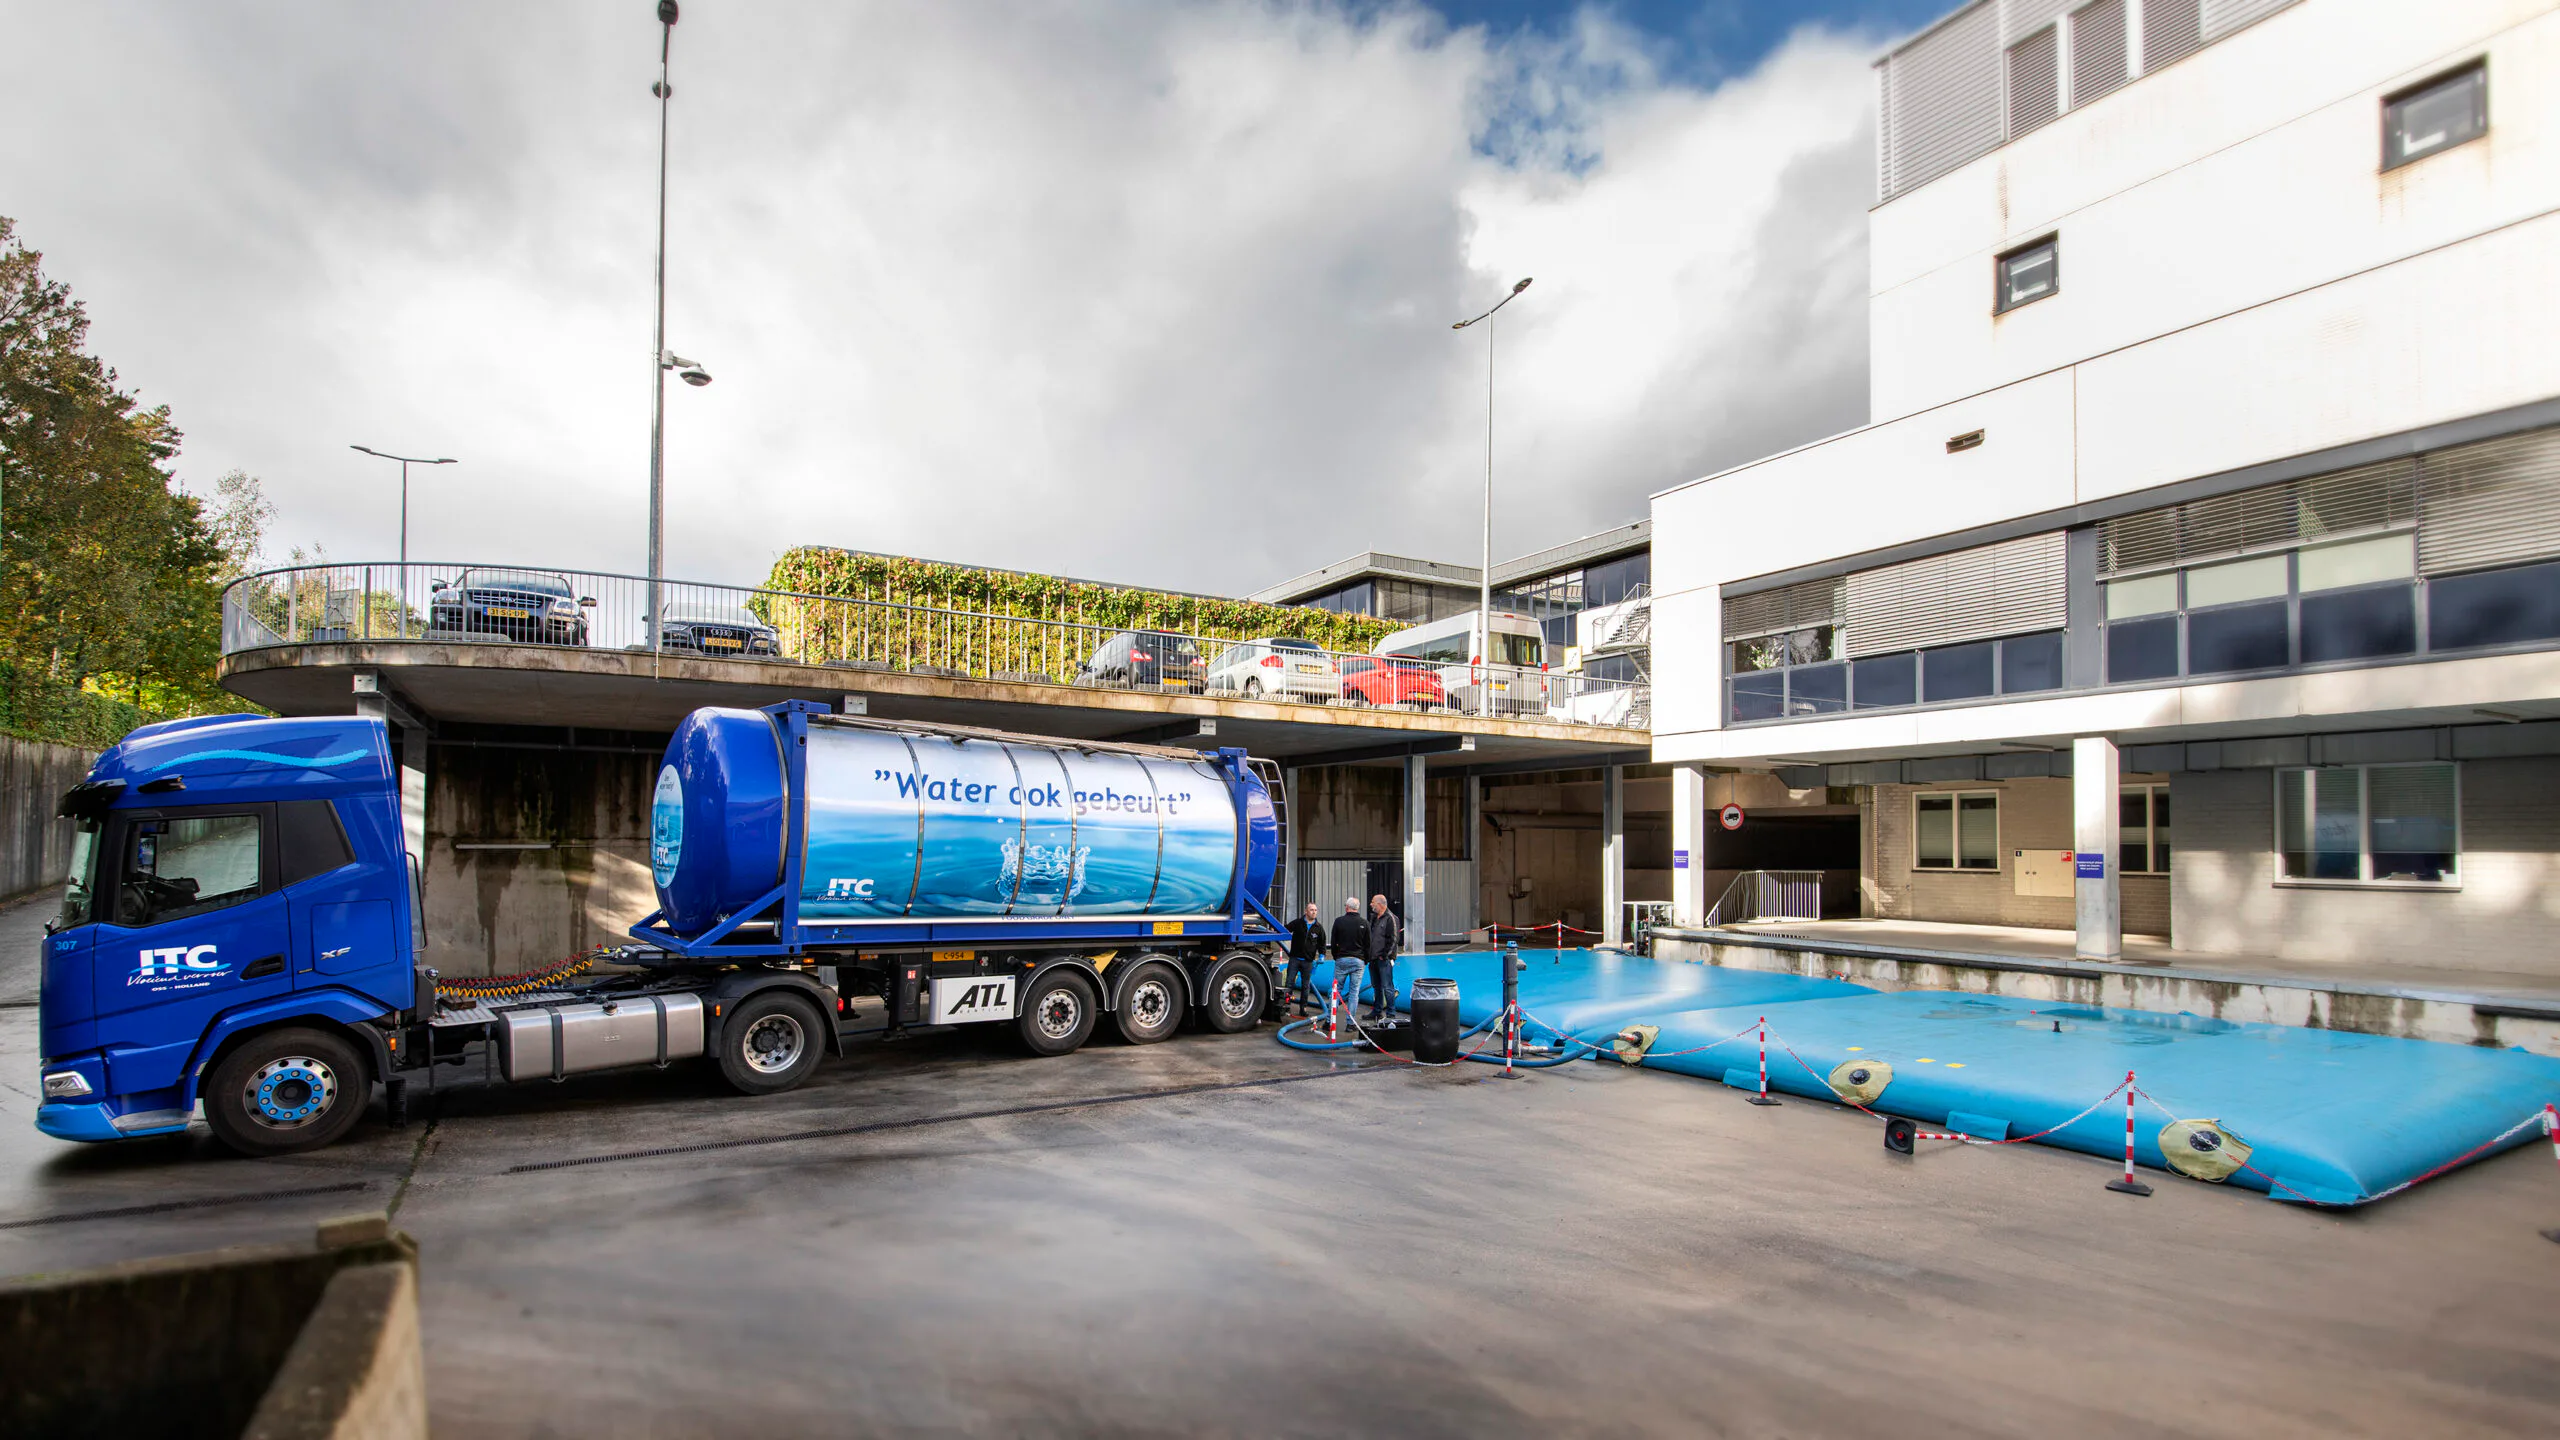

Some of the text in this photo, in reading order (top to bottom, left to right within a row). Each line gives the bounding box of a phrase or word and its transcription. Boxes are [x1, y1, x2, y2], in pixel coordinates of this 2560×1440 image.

[1008, 783, 1063, 808] ook
[827, 878, 875, 897] ITC
[55, 940, 78, 951] 307
[320, 946, 352, 960] XF
[139, 944, 218, 976] ITC
[174, 981, 211, 990] HOLLAND
[947, 983, 1008, 1016] ATL
